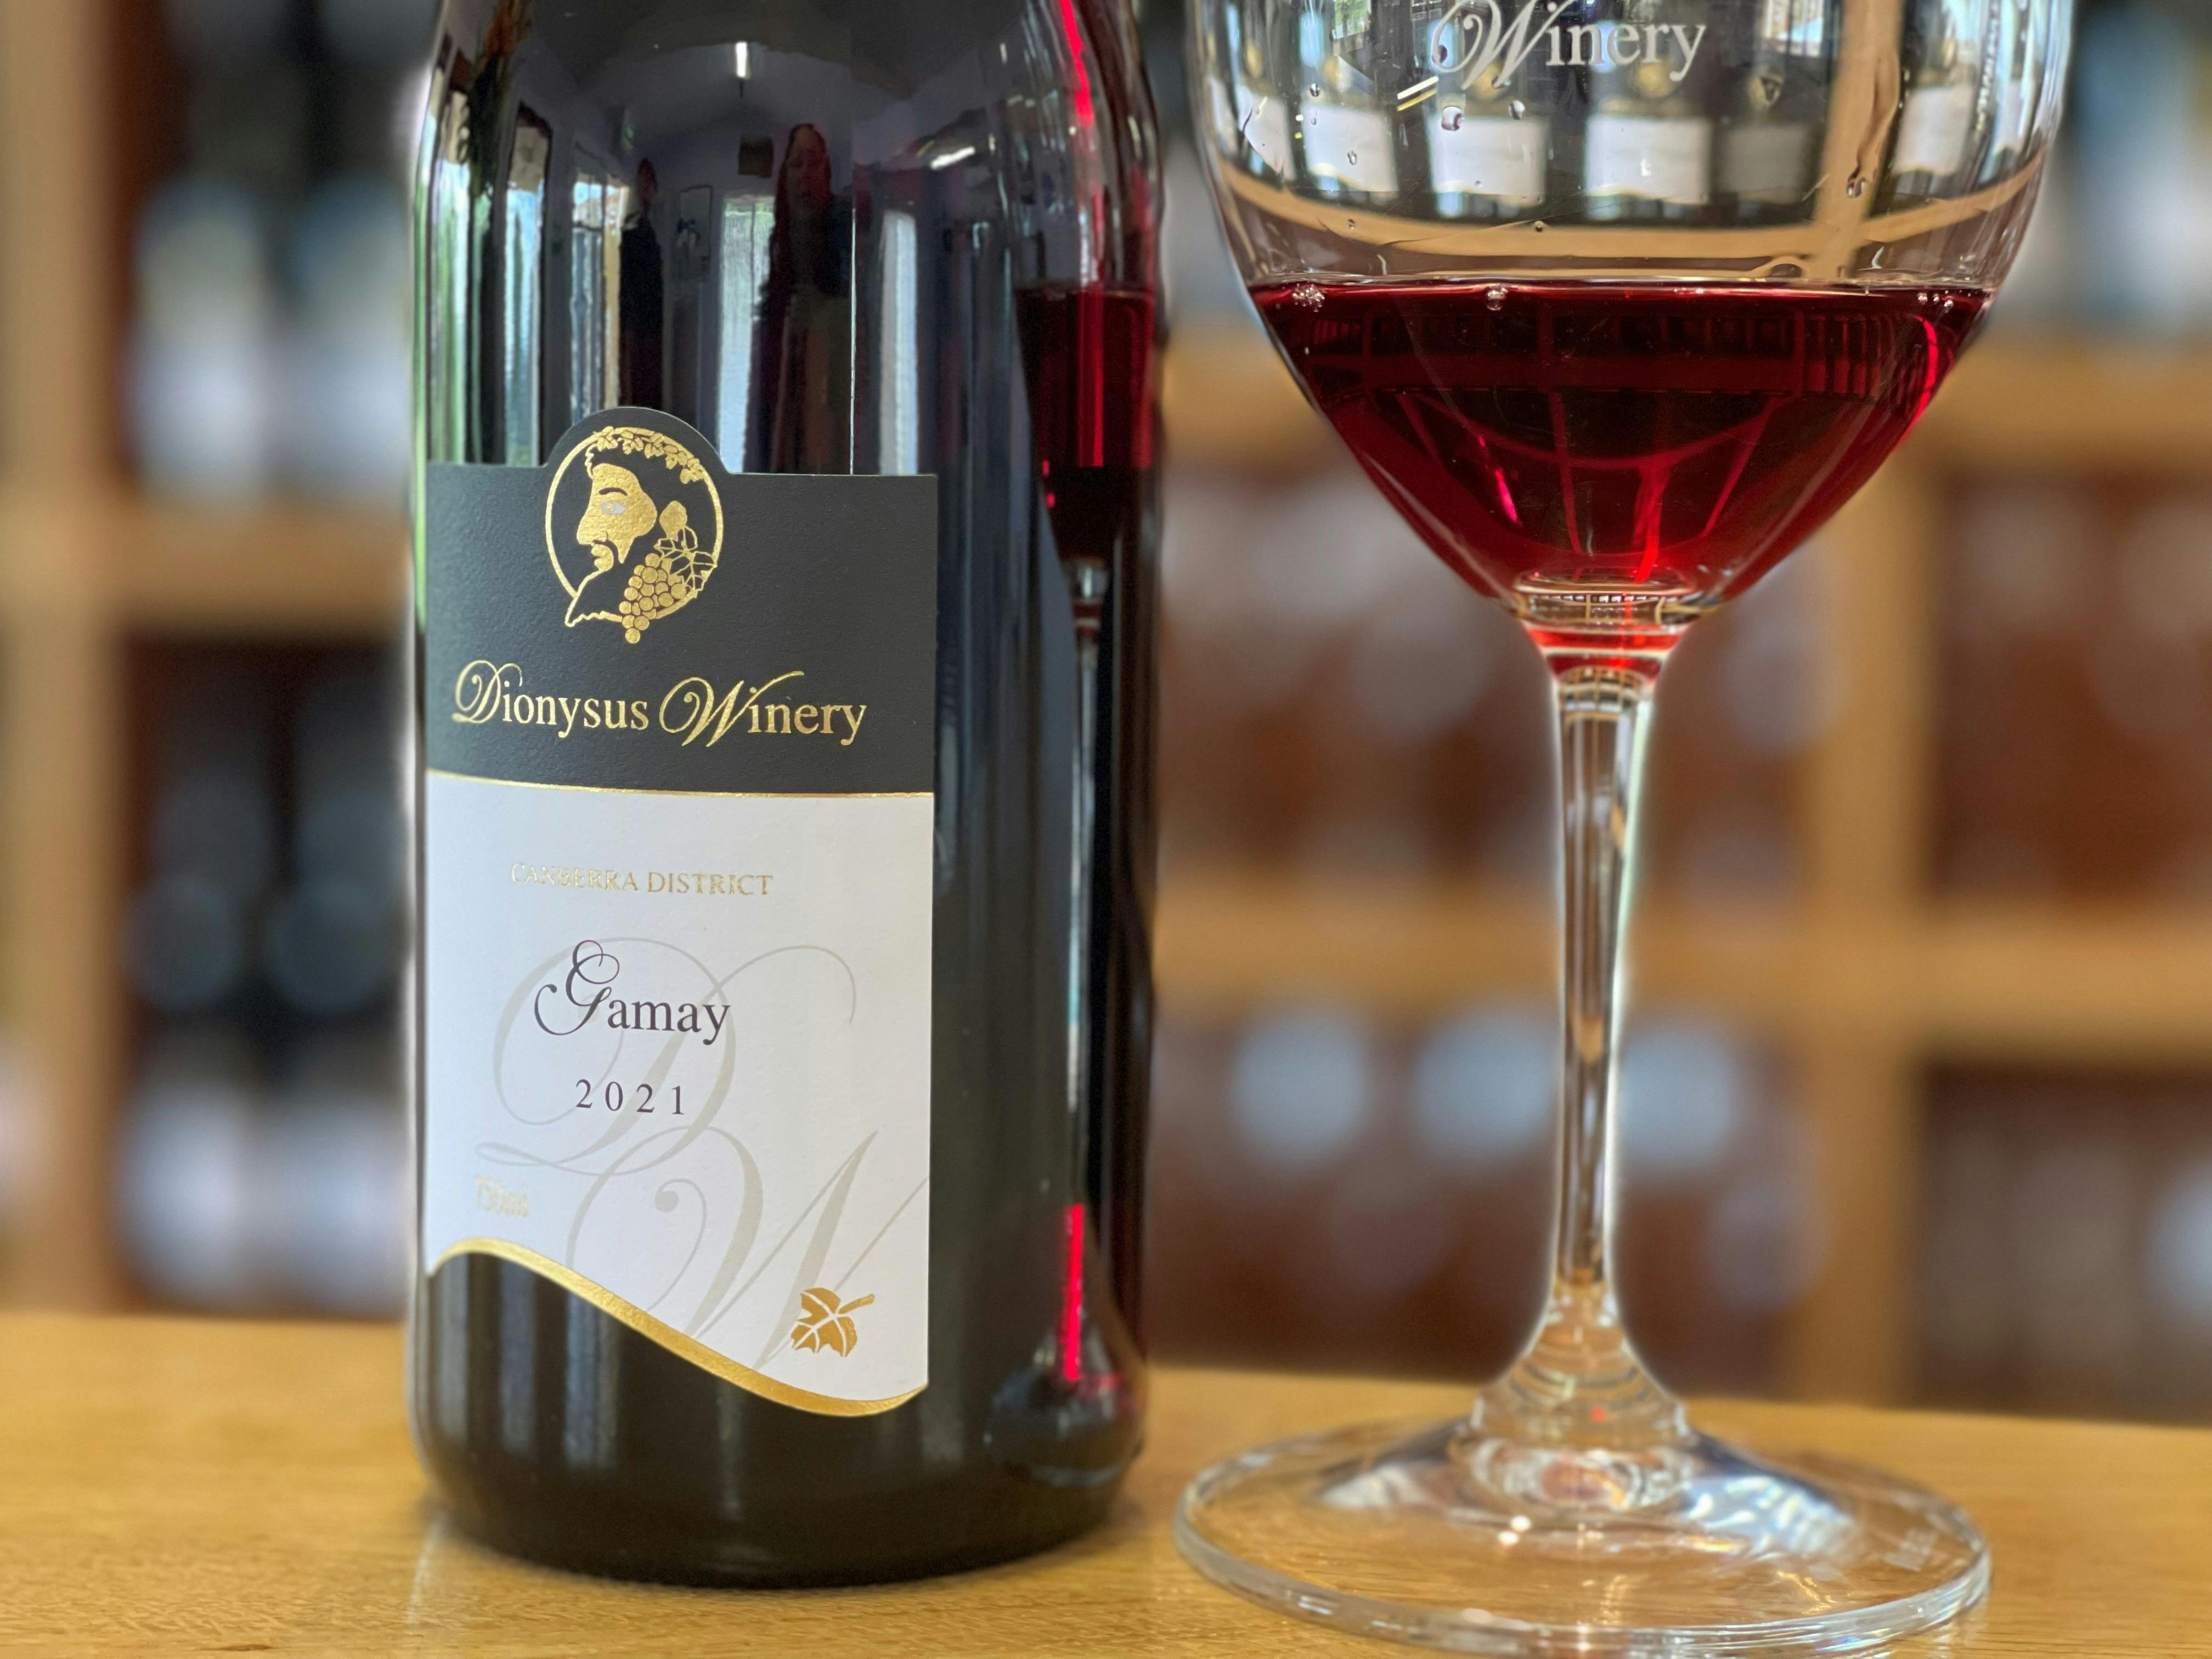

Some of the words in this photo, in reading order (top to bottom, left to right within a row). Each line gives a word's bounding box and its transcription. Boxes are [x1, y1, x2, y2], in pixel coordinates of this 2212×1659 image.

[1432, 0, 1706, 89] Winery
[452, 659, 648, 738] Dionysus
[659, 670, 867, 747] Winery
[511, 862, 638, 892] CANBERRA
[646, 872, 774, 895] DISTRICT
[534, 940, 731, 1046] Gamay
[575, 1079, 685, 1115] 2021
